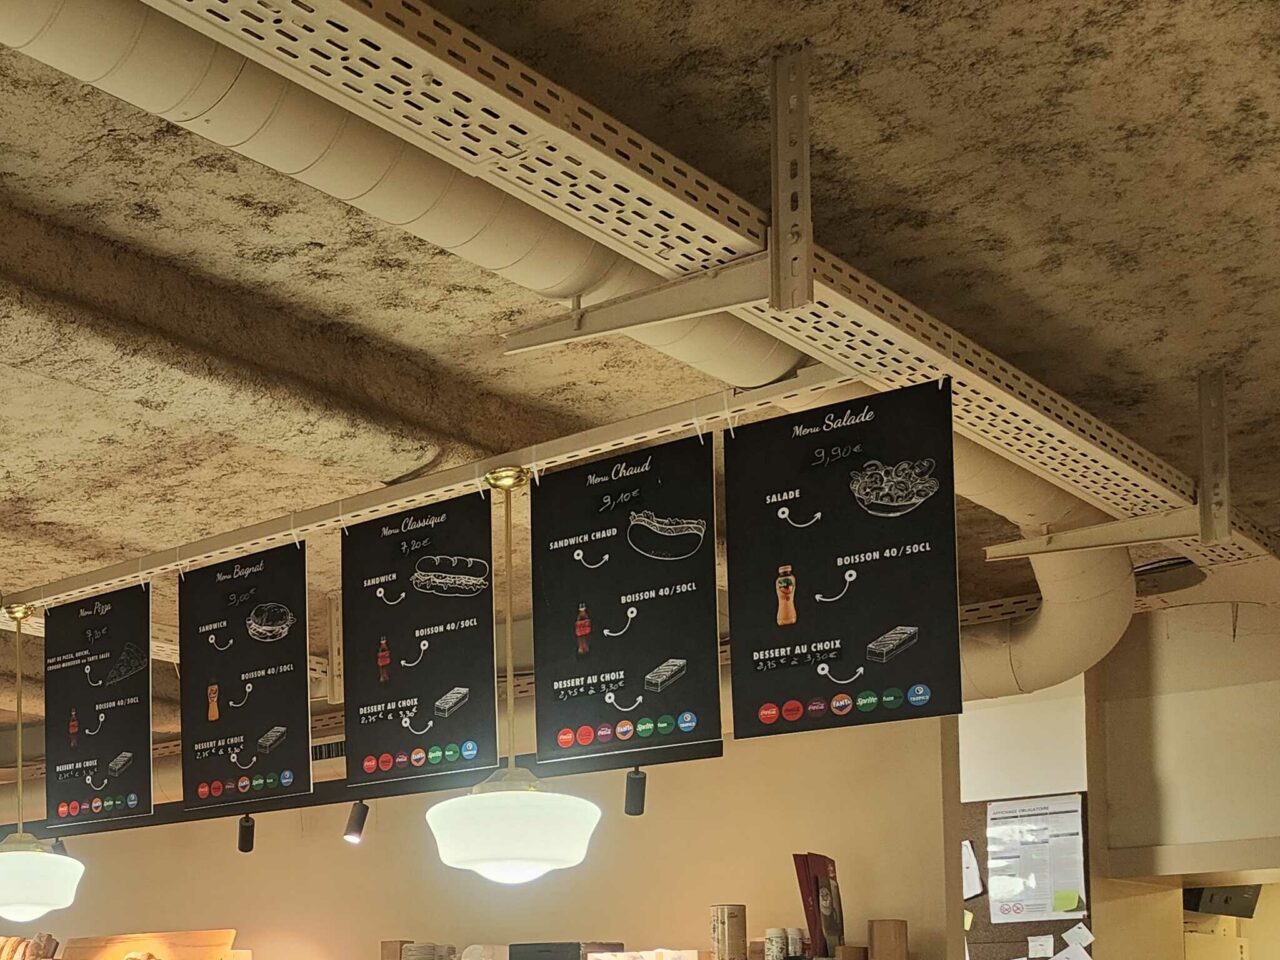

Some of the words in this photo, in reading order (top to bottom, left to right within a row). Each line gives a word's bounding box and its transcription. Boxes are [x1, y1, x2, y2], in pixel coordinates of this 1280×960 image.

[791, 424, 821, 439] Menu
[822, 405, 876, 431] Salade
[586, 474, 609, 486] Menu
[611, 456, 651, 480] Chaud
[766, 489, 800, 504] SALADE
[381, 526, 400, 537] Menu
[401, 513, 447, 532] Classique
[549, 534, 589, 550] SANDWICH
[591, 527, 617, 540] CHAUD
[837, 550, 880, 566] BOISSON
[233, 560, 265, 578] Bagnat
[363, 573, 397, 587] SANDWICH
[621, 590, 655, 604] BOISSON
[94, 602, 112, 615] Pizza
[199, 620, 227, 633] SANDWICH
[415, 625, 444, 637] BOISSON
[753, 646, 791, 660] DESSERT
[794, 644, 808, 654] AU
[811, 639, 841, 652] CHOIX
[241, 668, 266, 680] BOISSON
[554, 677, 584, 690] DESSERT
[587, 675, 597, 684] AU
[600, 671, 625, 682] CHOIX
[95, 701, 116, 710] BOISSON
[359, 703, 385, 715] DESSERT
[387, 701, 396, 709] AU
[398, 698, 418, 707] CHOIX
[194, 740, 216, 750] DESSERT
[226, 736, 244, 744] CHOIX
[56, 763, 74, 772] DESSERT
[83, 759, 97, 767] CHOIX
